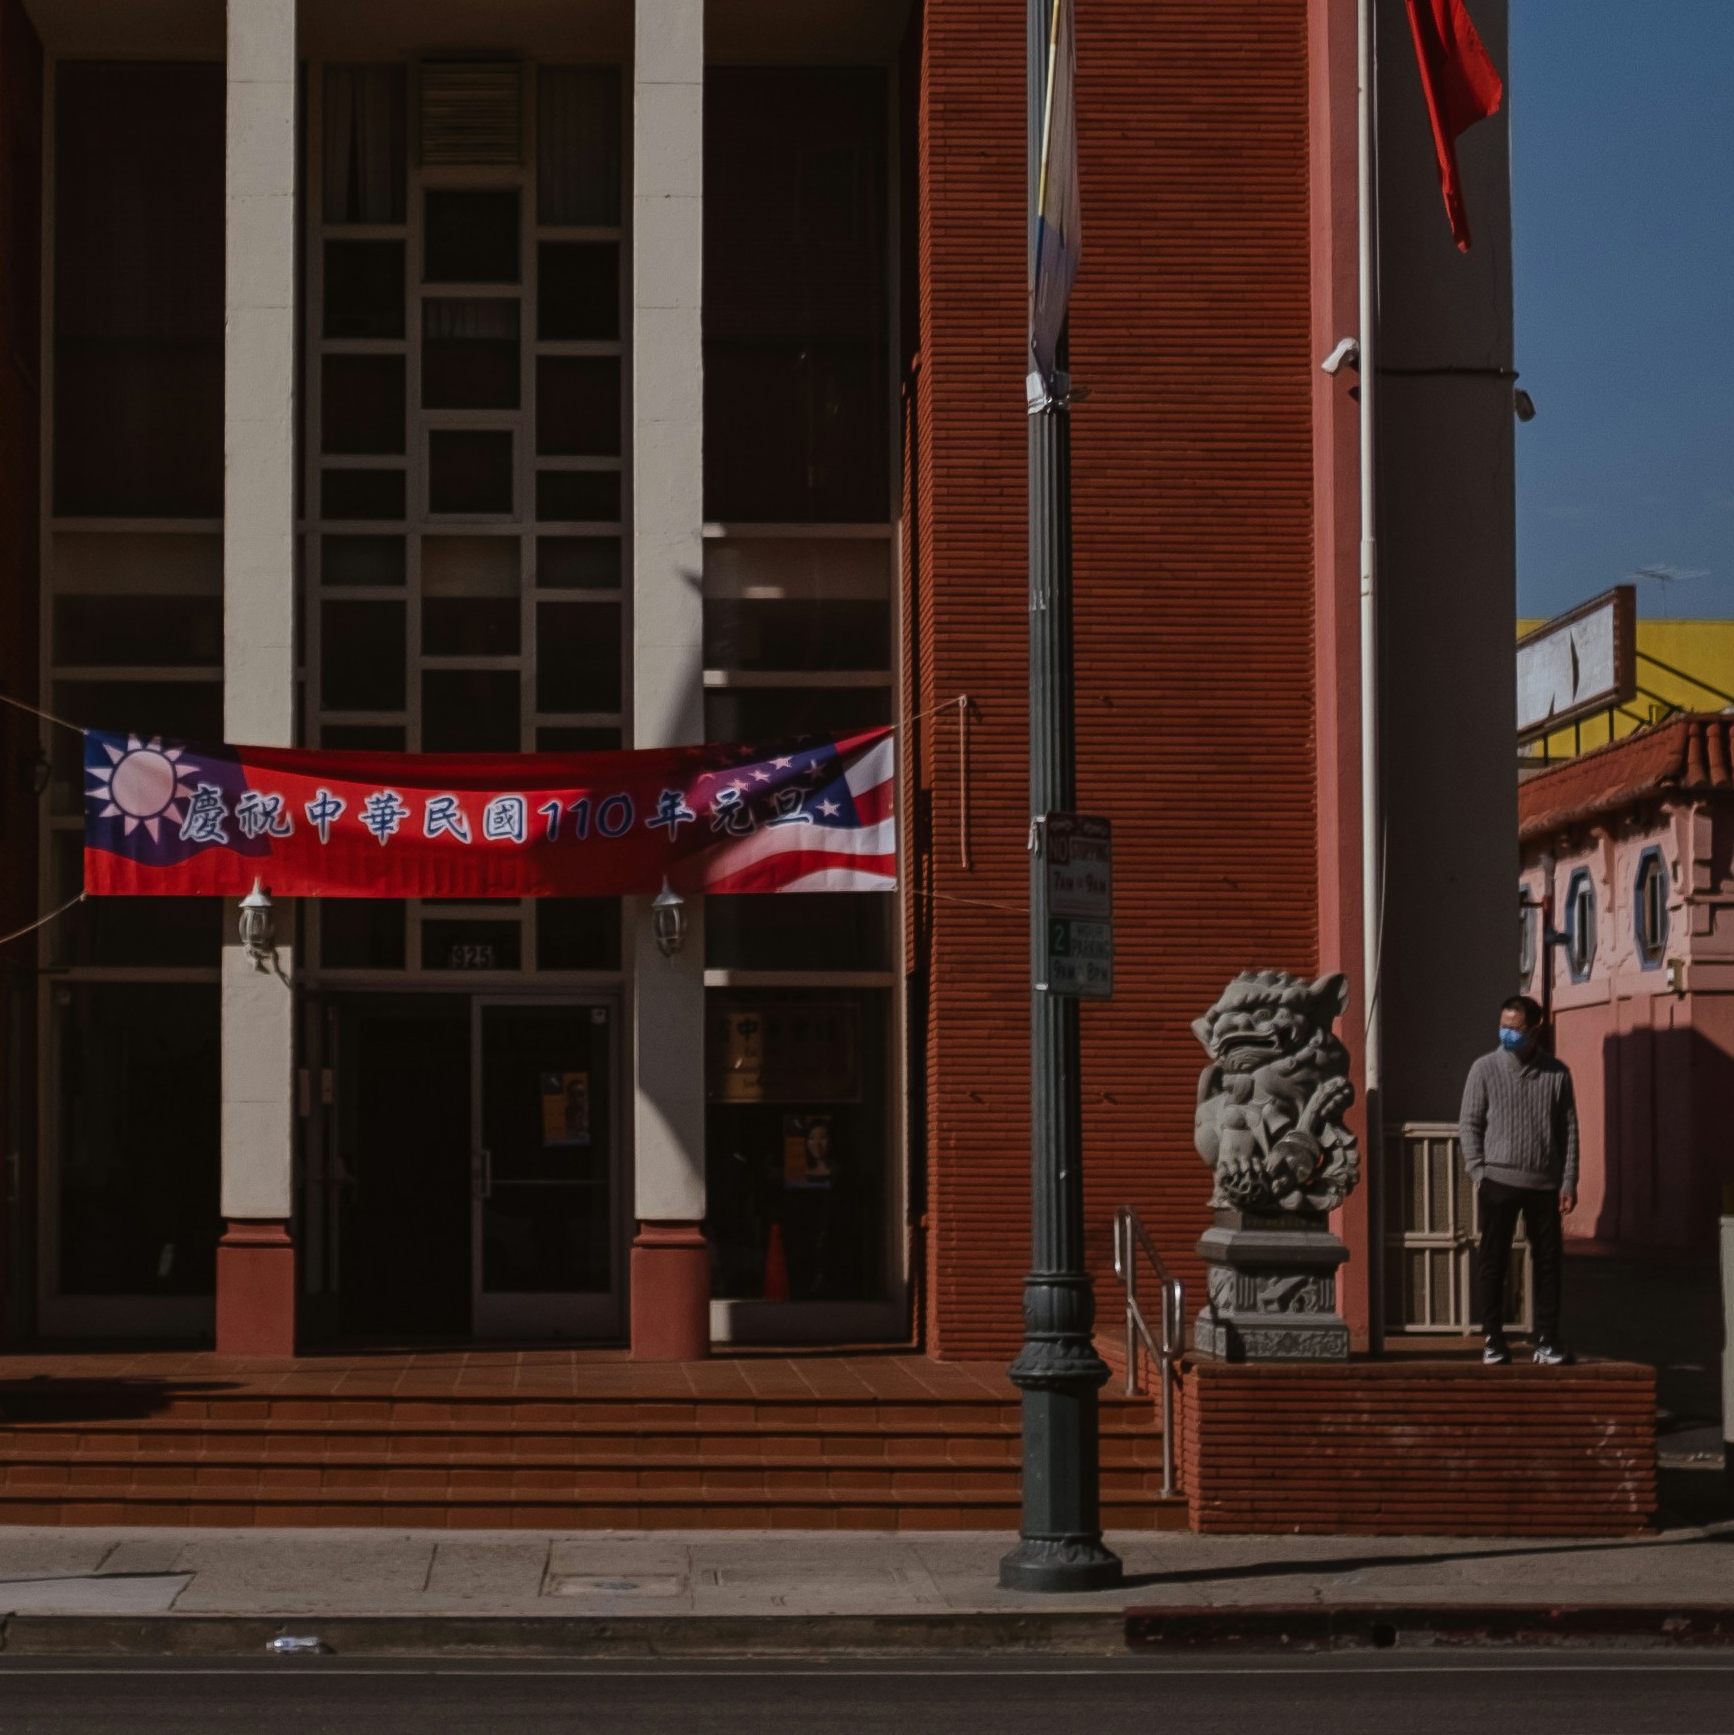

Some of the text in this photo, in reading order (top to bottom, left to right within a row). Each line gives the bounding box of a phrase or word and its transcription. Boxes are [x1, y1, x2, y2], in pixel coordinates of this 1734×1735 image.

[178, 781, 816, 848] 慶祝中華民國110年元旦
[1049, 835, 1068, 863] NO
[1054, 923, 1066, 952] 2
[454, 946, 490, 970] 925
